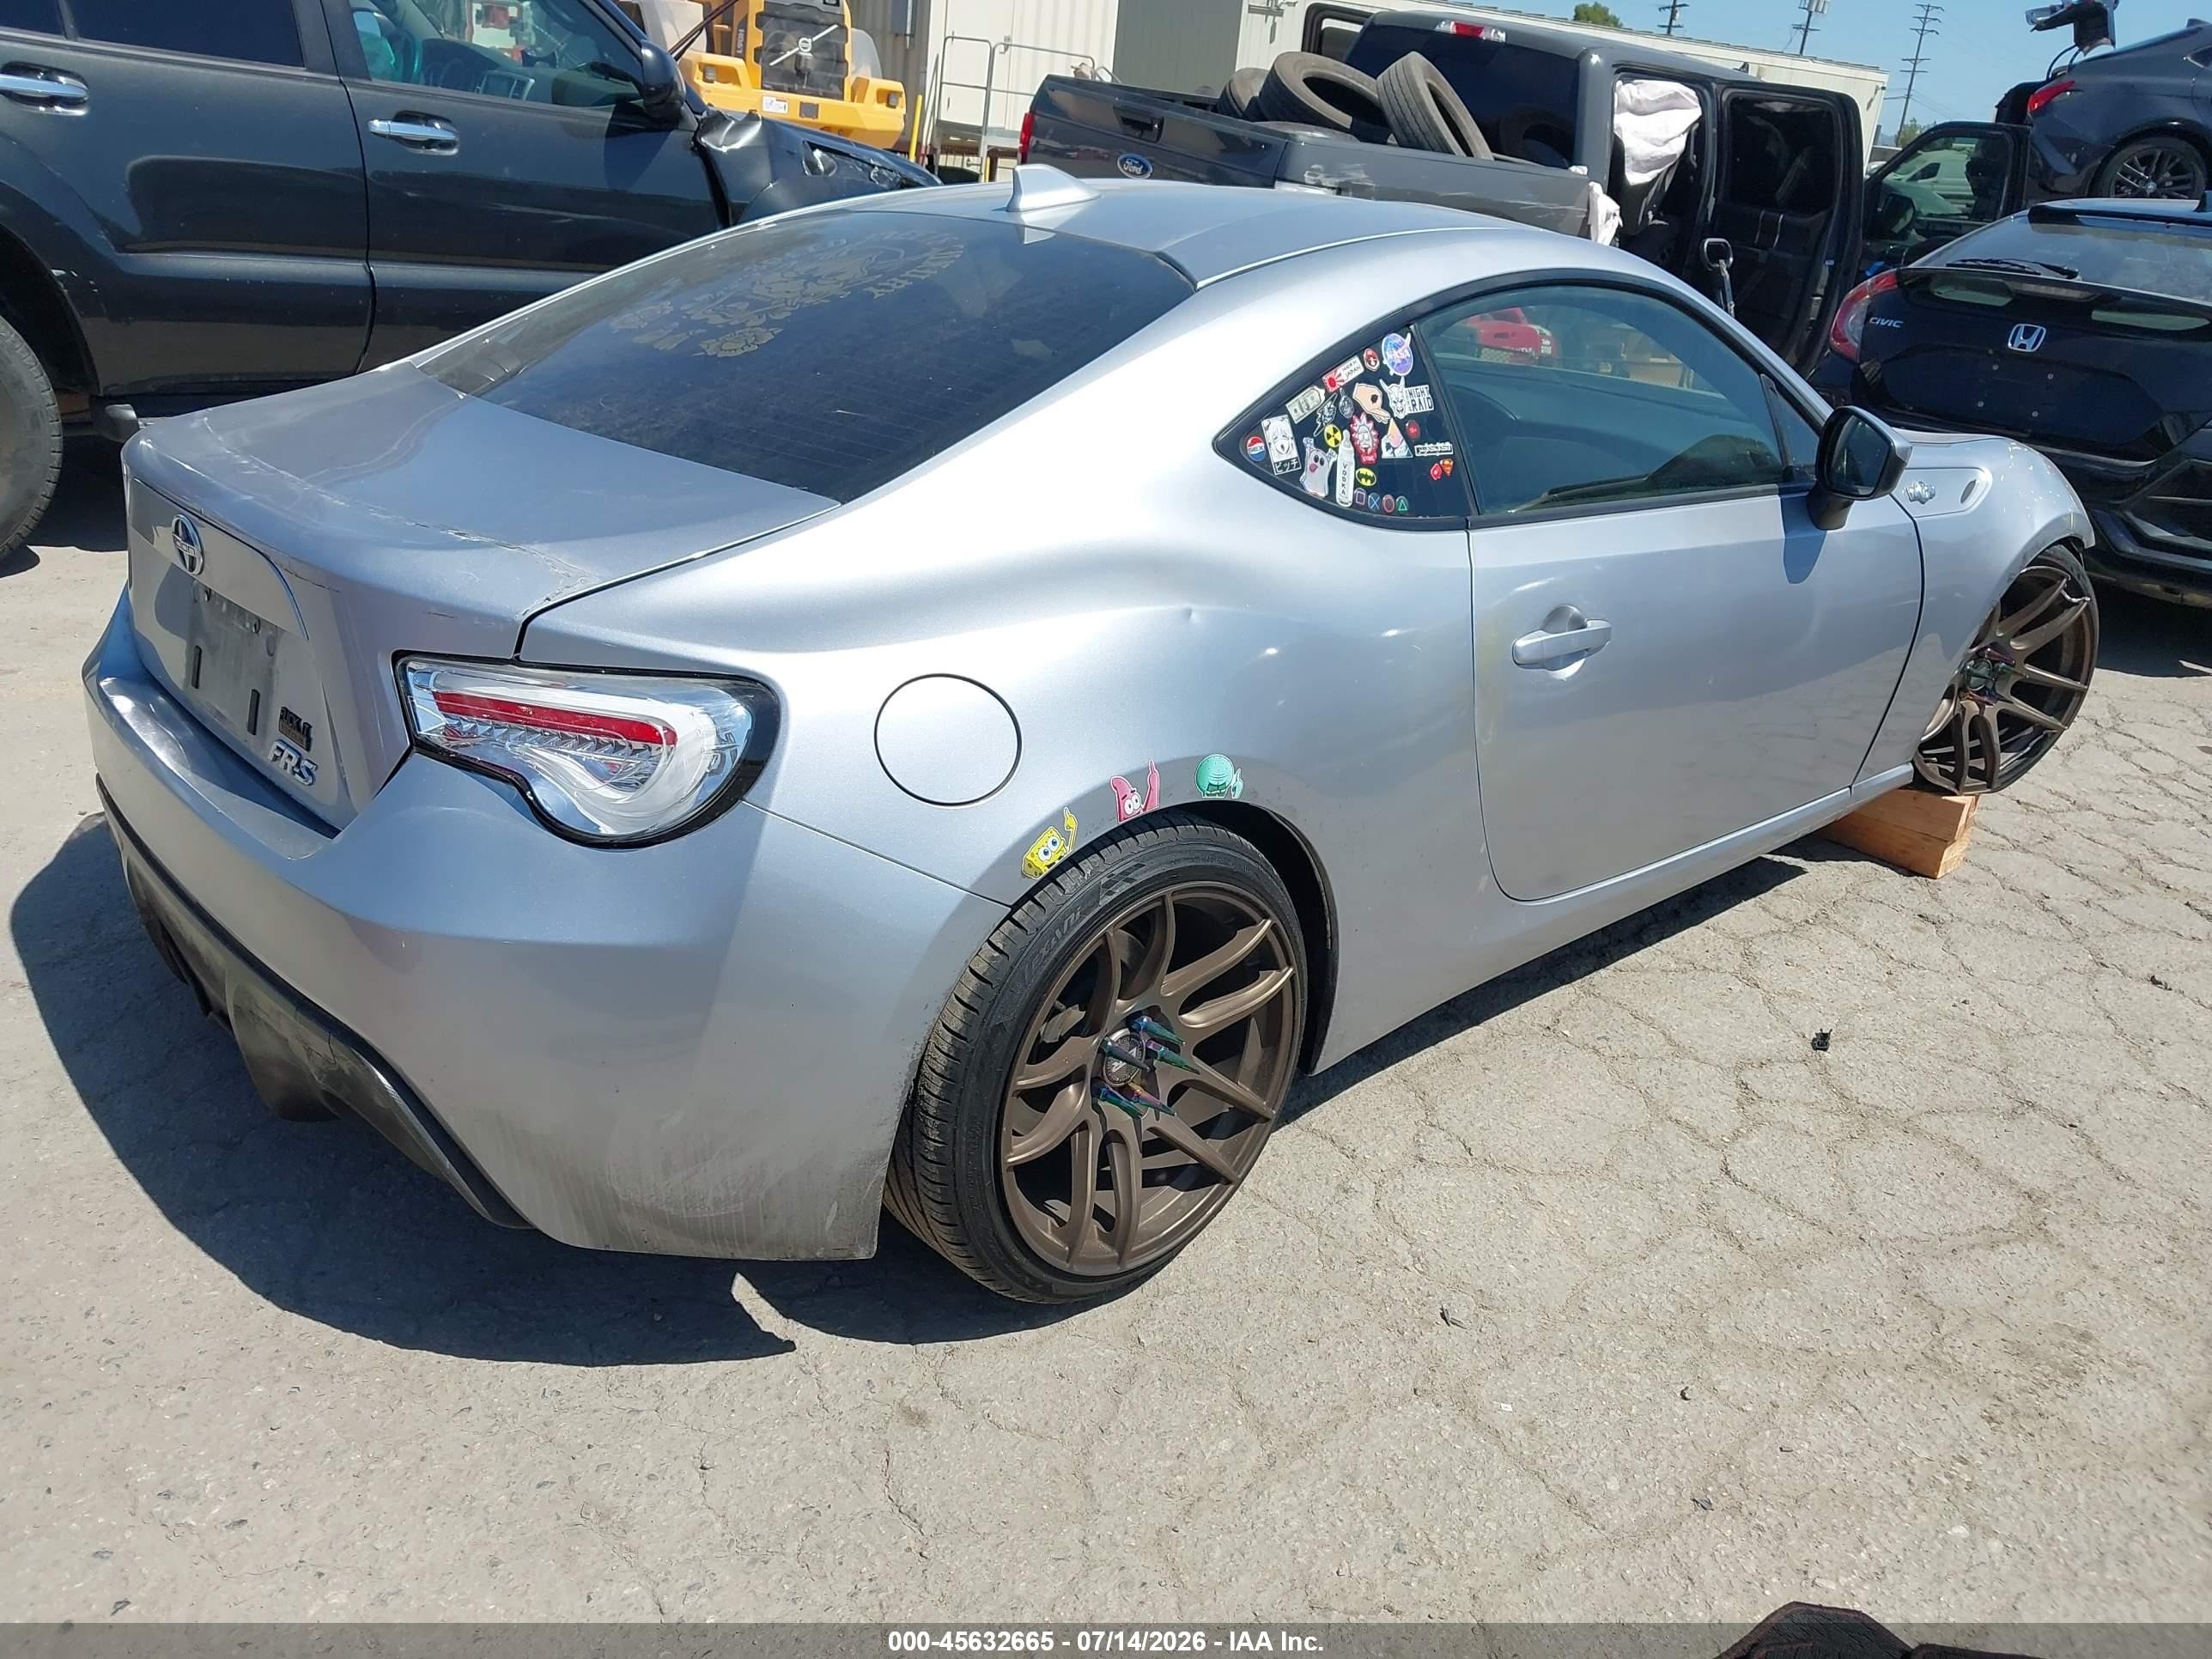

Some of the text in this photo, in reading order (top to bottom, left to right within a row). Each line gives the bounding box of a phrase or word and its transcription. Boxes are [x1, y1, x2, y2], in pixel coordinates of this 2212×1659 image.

[1123, 158, 1144, 174] Ford
[1869, 317, 1904, 328] CIVIC
[1407, 386, 1430, 398] NIGHT
[1411, 396, 1433, 411] RAID
